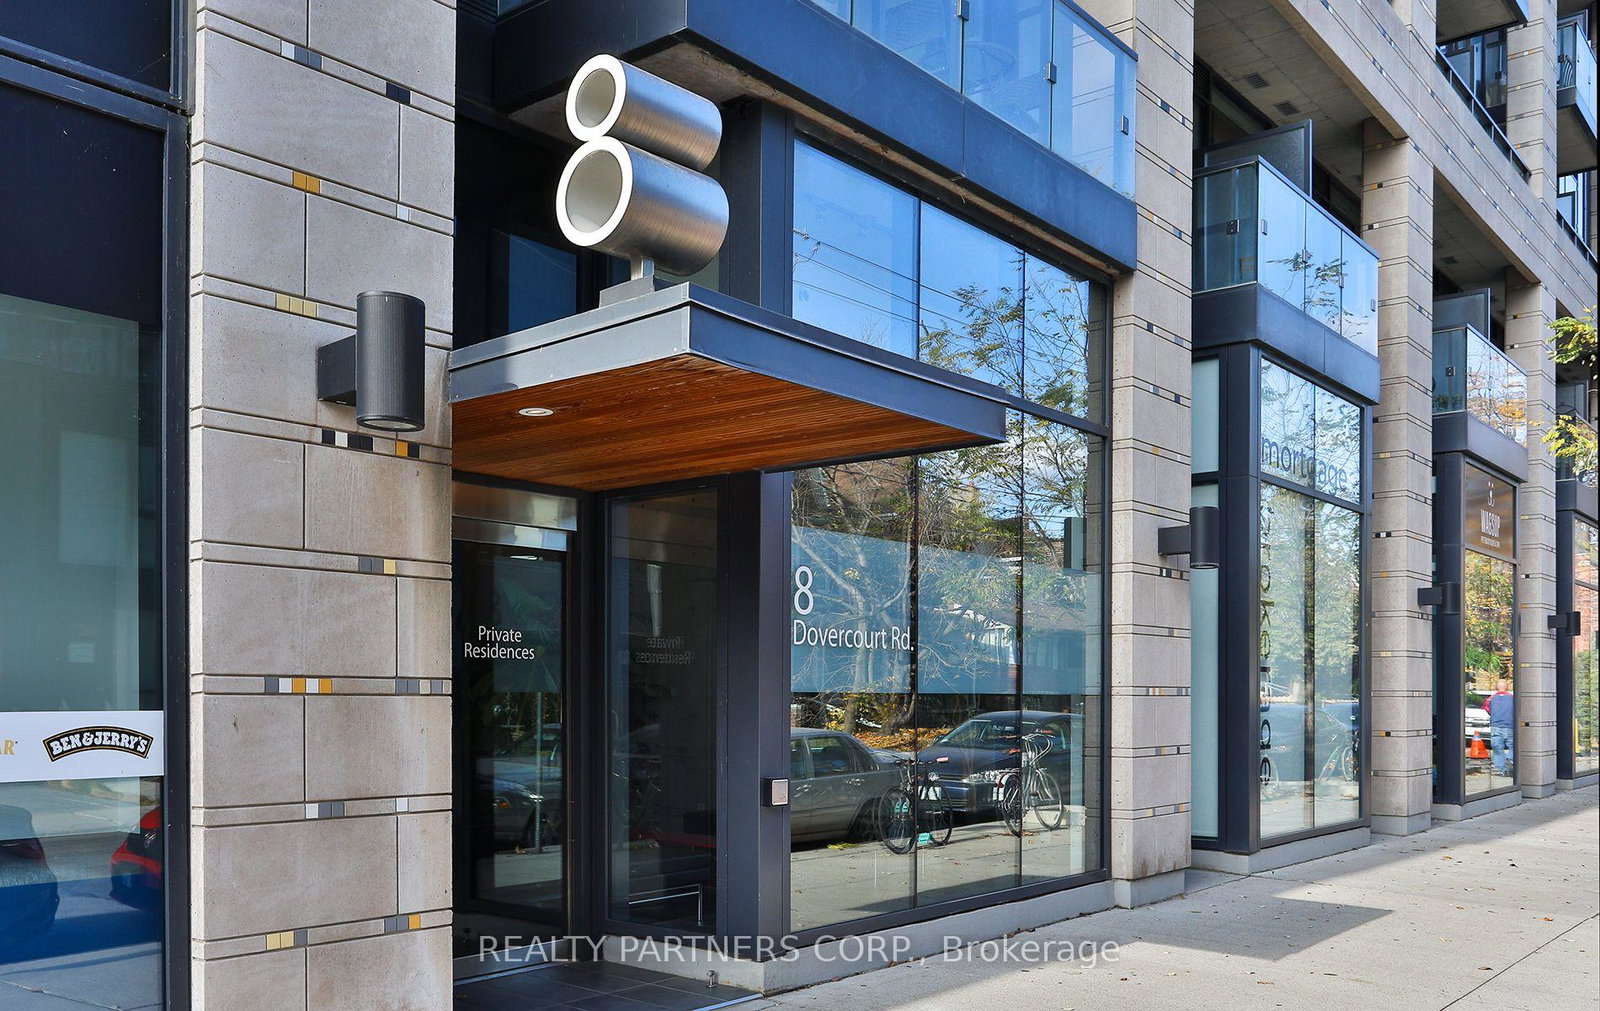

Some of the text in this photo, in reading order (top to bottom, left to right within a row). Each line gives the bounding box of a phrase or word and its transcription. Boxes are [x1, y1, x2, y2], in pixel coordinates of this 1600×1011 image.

[1261, 436, 1348, 496] mortgage
[794, 565, 814, 616] 8
[478, 625, 523, 643] Private
[793, 619, 915, 652] Dovercourt Rd.
[464, 642, 536, 660] Residences
